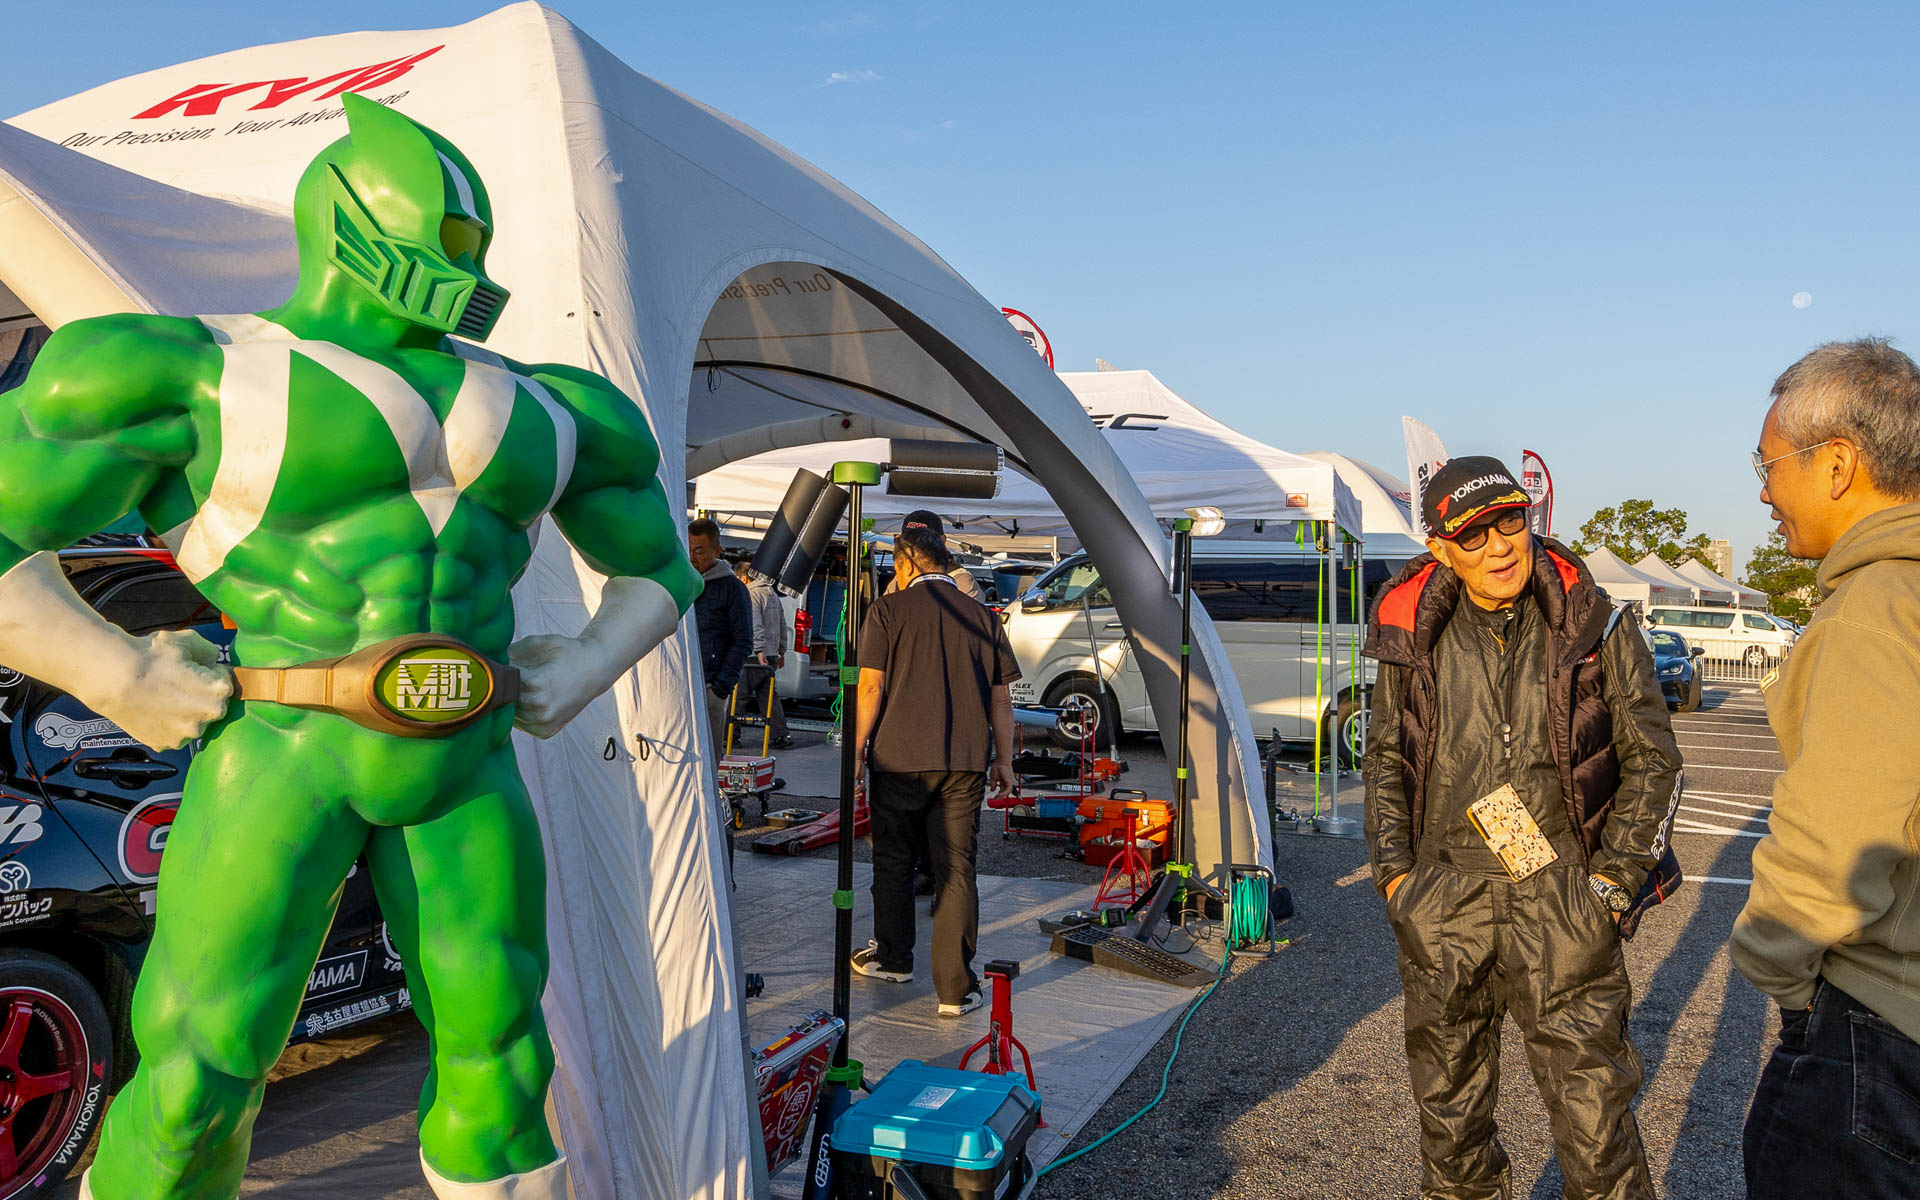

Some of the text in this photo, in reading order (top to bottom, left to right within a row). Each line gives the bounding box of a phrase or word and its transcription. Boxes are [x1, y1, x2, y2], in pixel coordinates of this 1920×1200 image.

[130, 45, 446, 119] KYB
[60, 90, 411, 148] Our Precision, Your Advage
[1450, 473, 1513, 502] YOKOHAMA
[81, 739, 130, 748] maintenance
[15, 913, 51, 925] Corporation
[33, 1007, 58, 1032] ADVAN
[55, 1083, 102, 1164] YOKOHAMA
